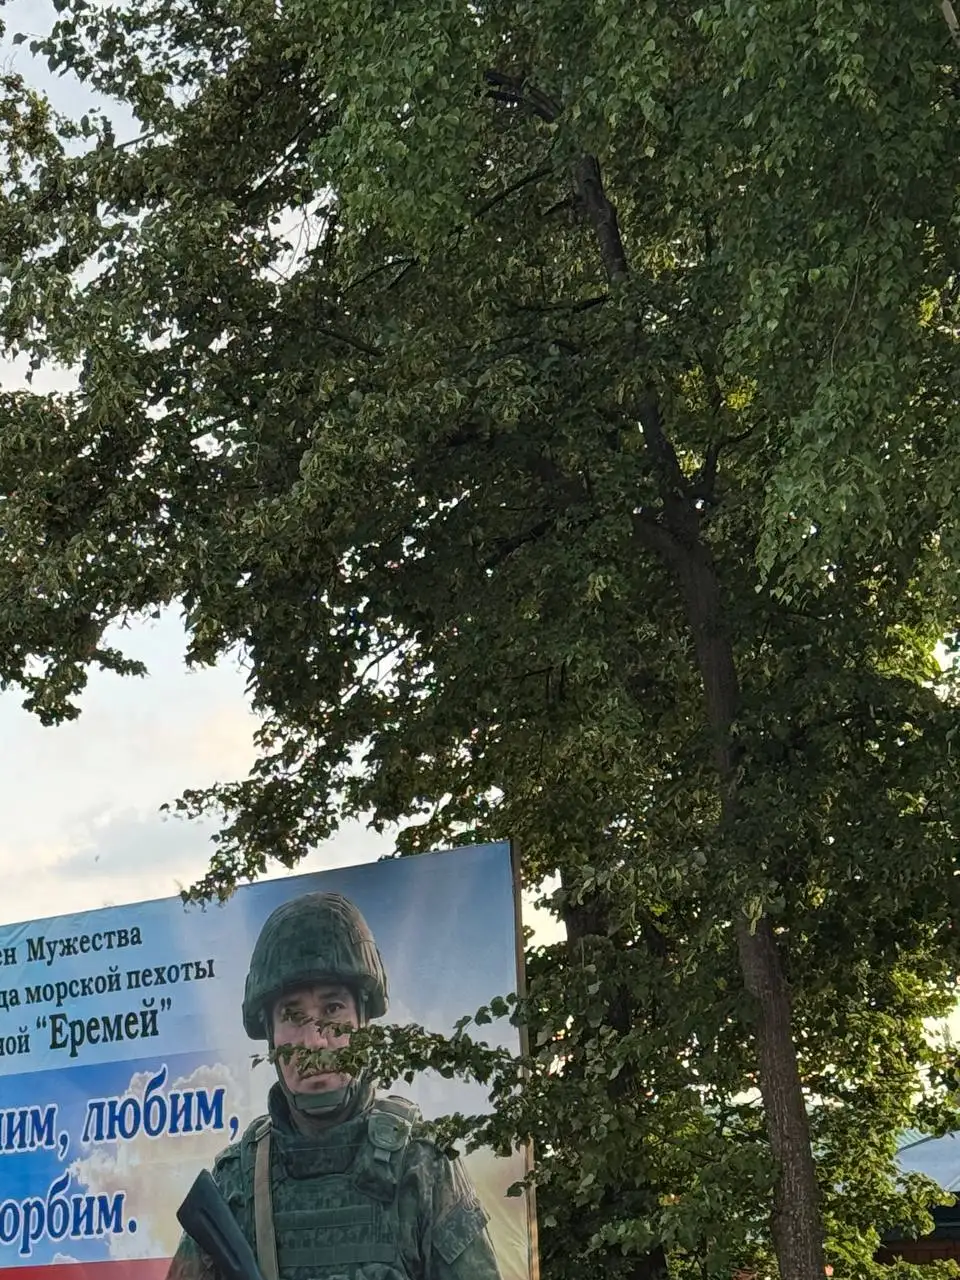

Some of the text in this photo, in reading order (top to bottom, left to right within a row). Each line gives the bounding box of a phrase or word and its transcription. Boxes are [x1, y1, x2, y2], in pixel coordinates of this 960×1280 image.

[26, 925, 143, 968] Мужества
[25, 966, 121, 1004] морской
[126, 958, 216, 989] пехоты
[82, 1064, 240, 1144] любим,
